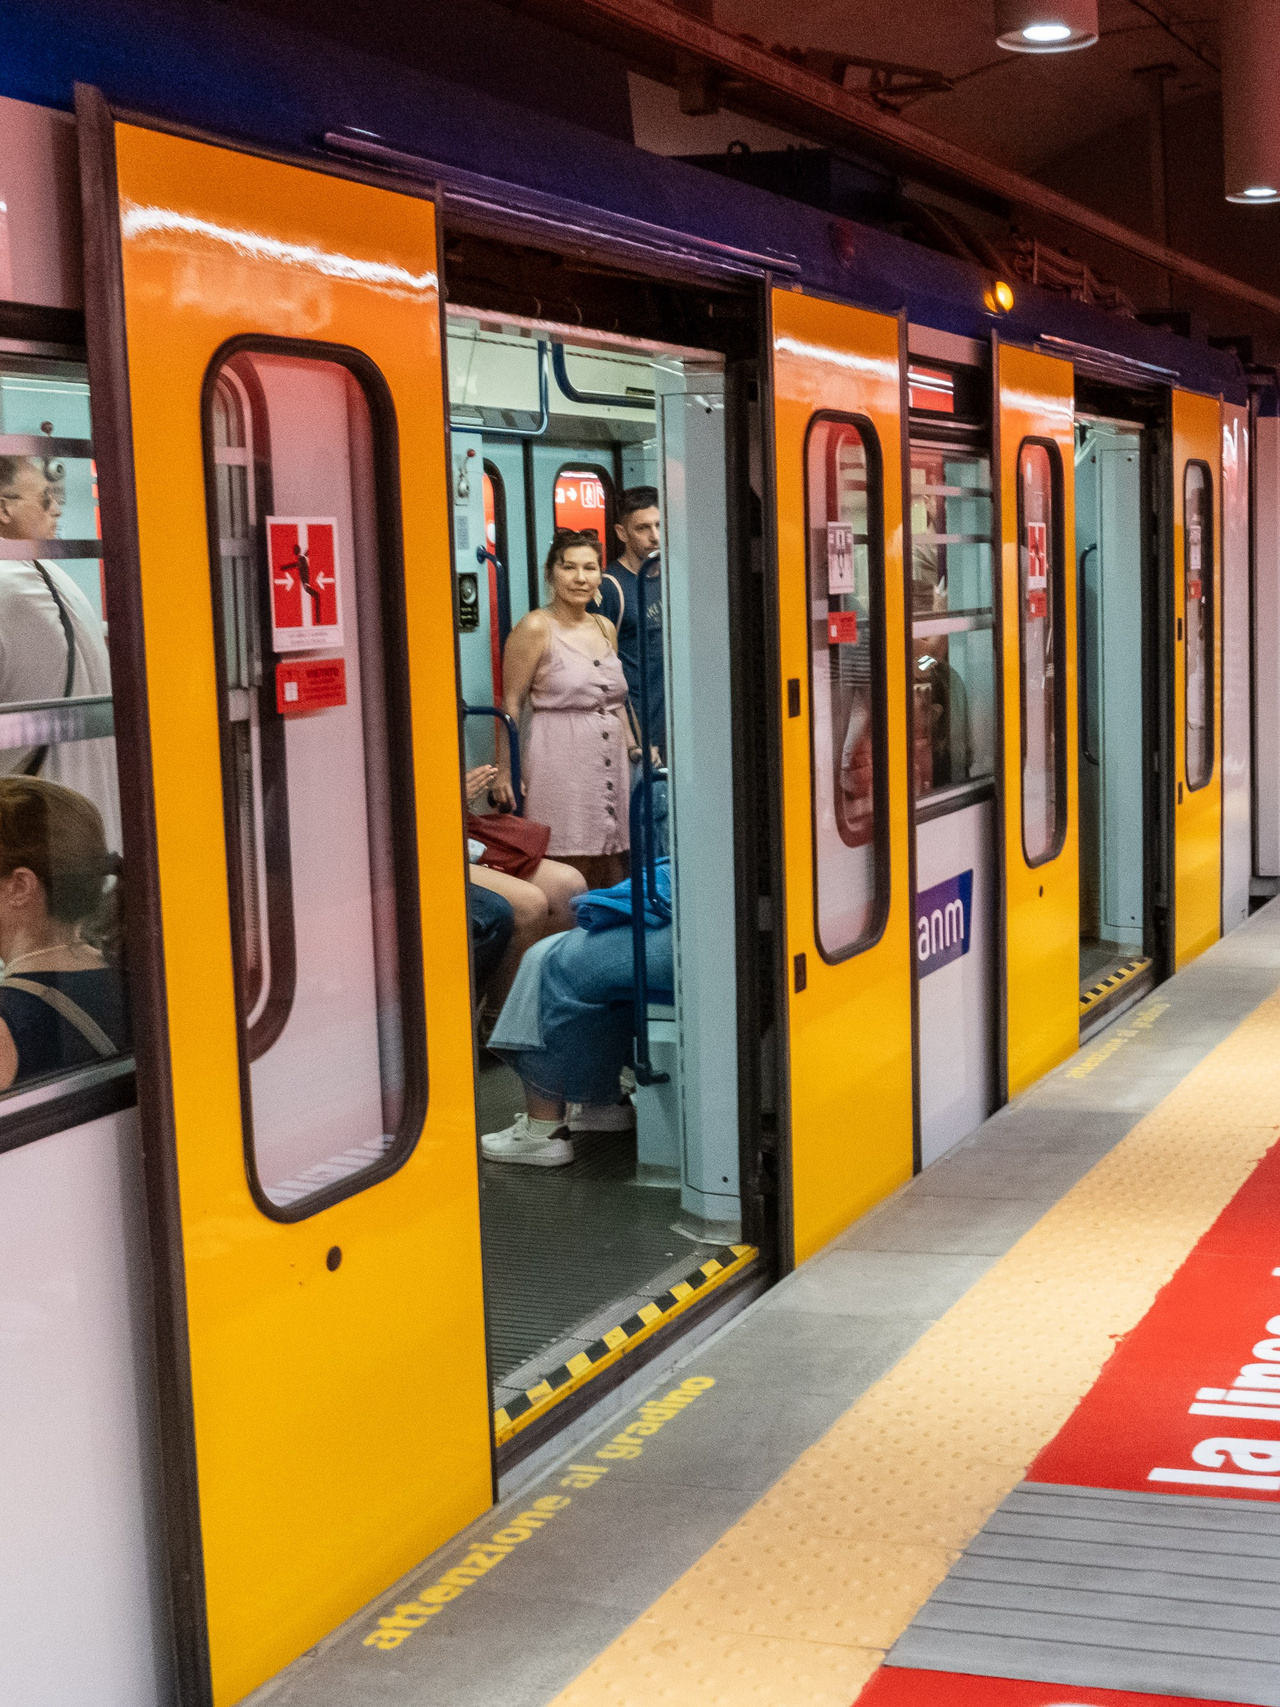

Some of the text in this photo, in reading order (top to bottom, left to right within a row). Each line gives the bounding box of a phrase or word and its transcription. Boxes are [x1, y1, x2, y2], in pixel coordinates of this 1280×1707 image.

[918, 898, 965, 961] anm
[363, 1376, 716, 1650] attenzione al gradino
